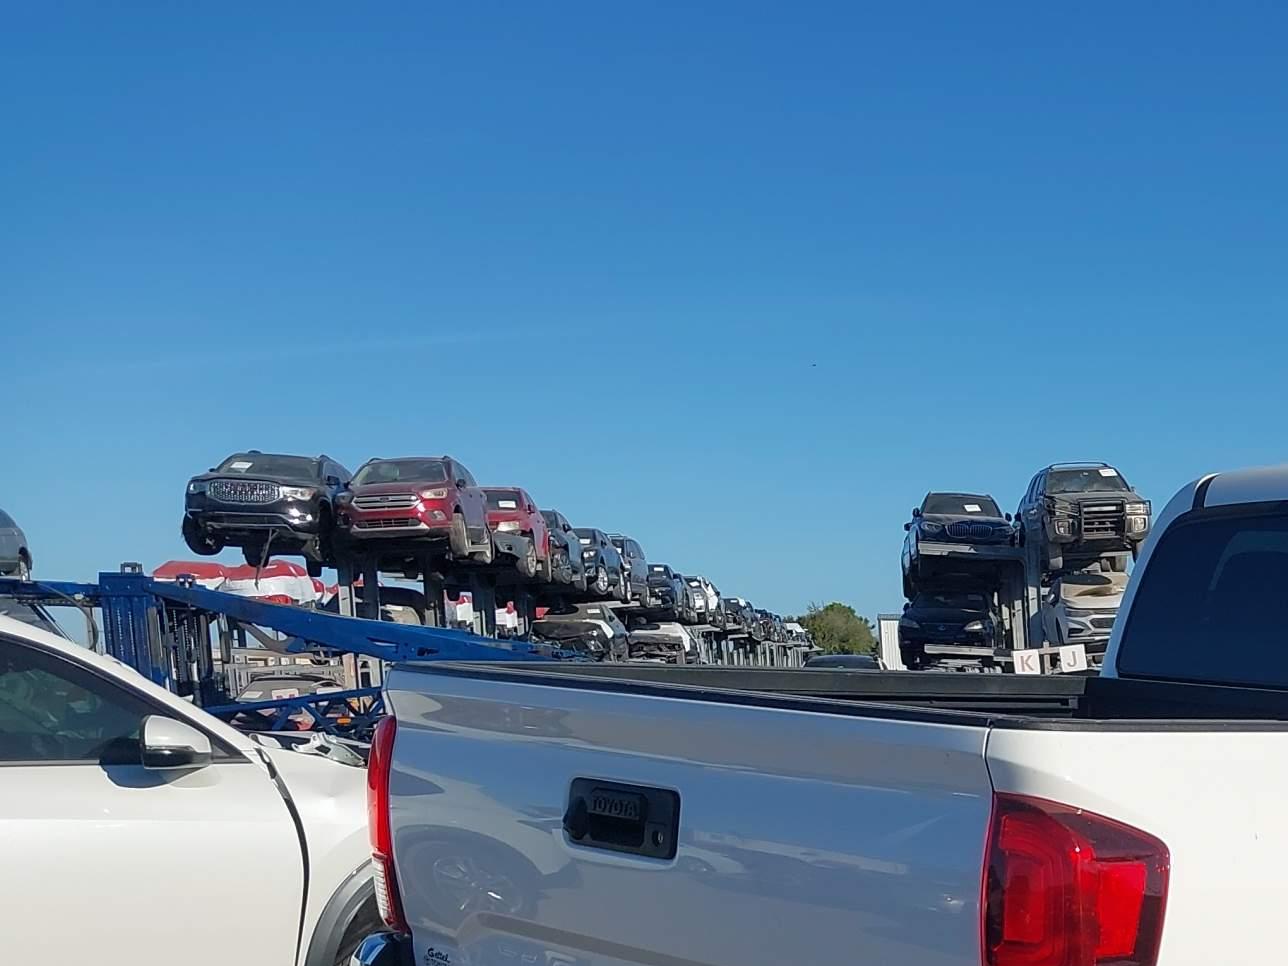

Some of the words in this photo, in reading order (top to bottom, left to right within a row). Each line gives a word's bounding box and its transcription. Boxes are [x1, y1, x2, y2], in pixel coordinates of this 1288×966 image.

[1020, 654, 1035, 672] K
[1066, 650, 1078, 668] J
[592, 796, 640, 818] TOYOTA
